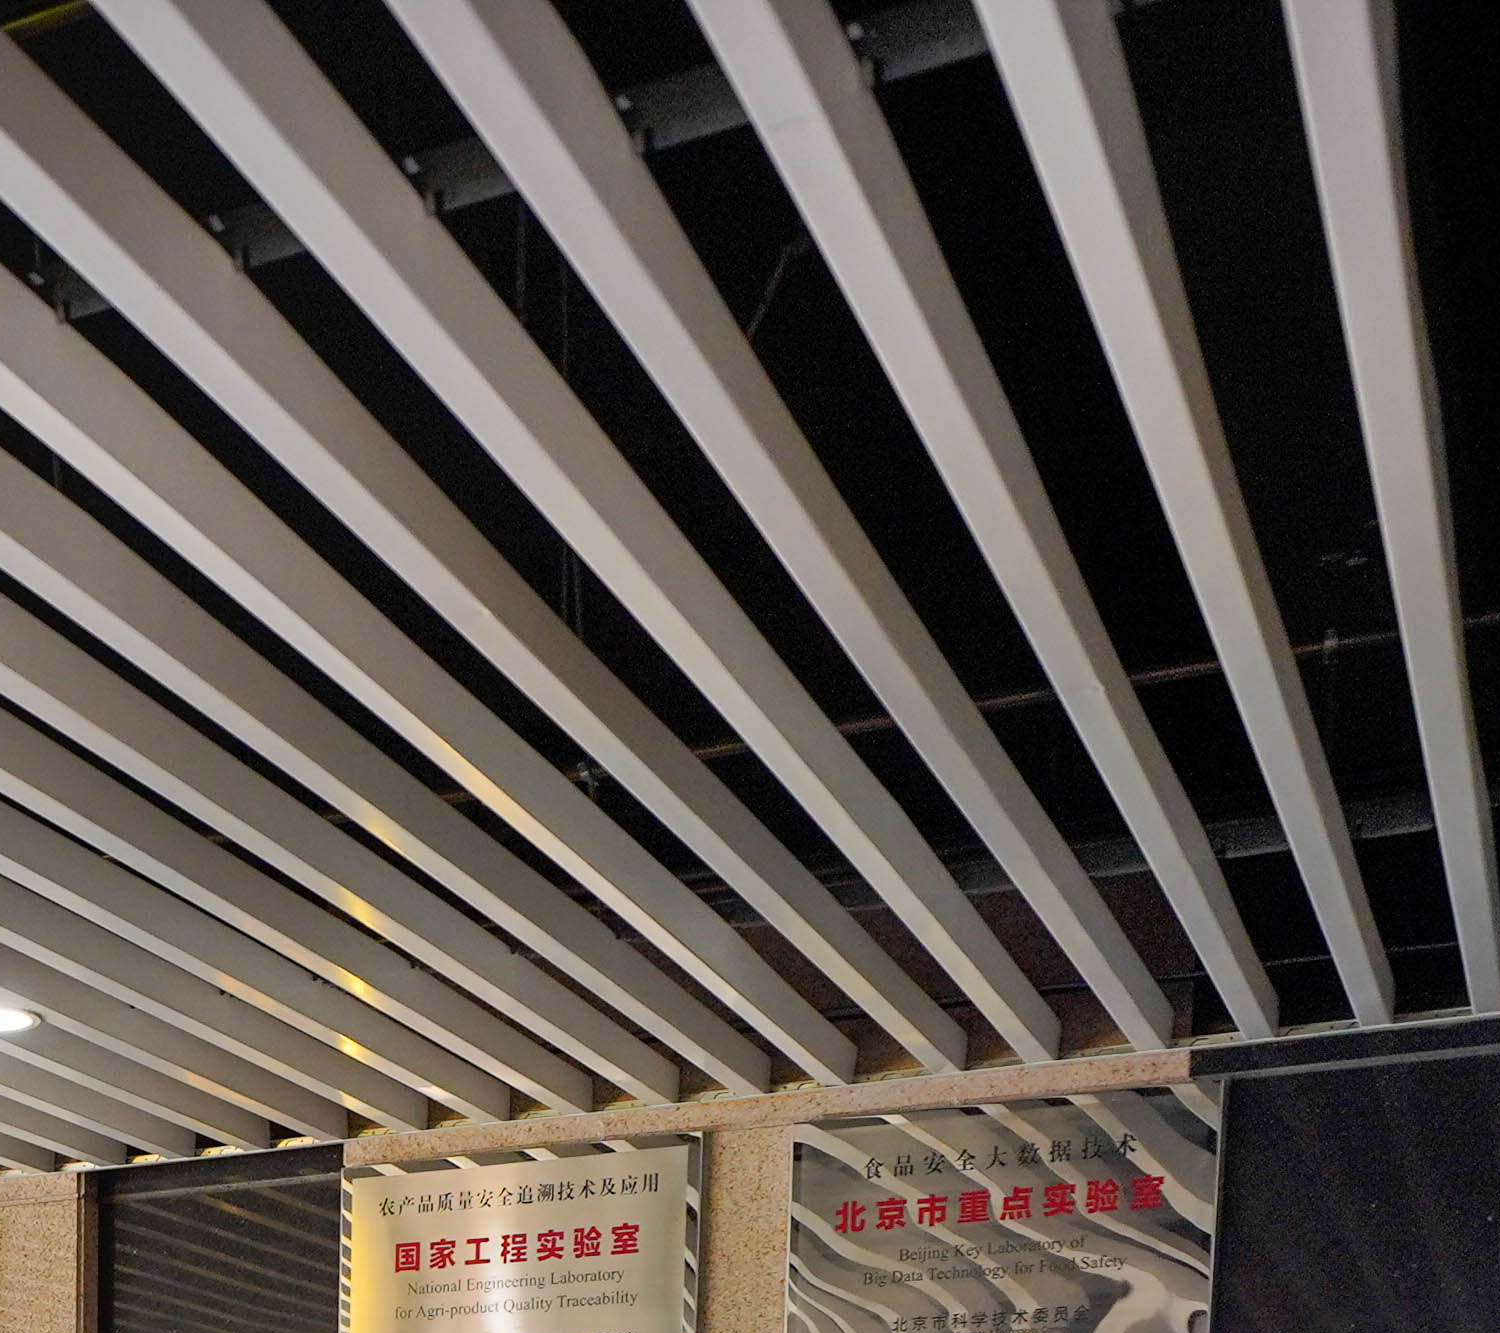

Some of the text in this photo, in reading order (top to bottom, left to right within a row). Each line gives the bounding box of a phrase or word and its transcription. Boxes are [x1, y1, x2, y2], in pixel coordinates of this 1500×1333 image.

[864, 1132, 1138, 1180] 食品安全大数据技术
[378, 1172, 660, 1217] 农产品质量安全追溯技术及应用
[834, 1172, 1165, 1234] 北京市重点实验室
[394, 1222, 641, 1273] 国家工程实验室
[899, 1234, 1088, 1264] Beijing Key Laboratory of
[407, 1268, 625, 1296] National Engineering Laboratory
[863, 1271, 888, 1288] Big
[891, 1270, 924, 1285] Data
[928, 1263, 1009, 1281] Technology
[1015, 1260, 1035, 1275] for
[1080, 1254, 1130, 1271] Safety
[395, 1290, 638, 1321] for Agri-product Quality Traceability
[891, 1304, 1091, 1333] 北京市科学技术委员会
